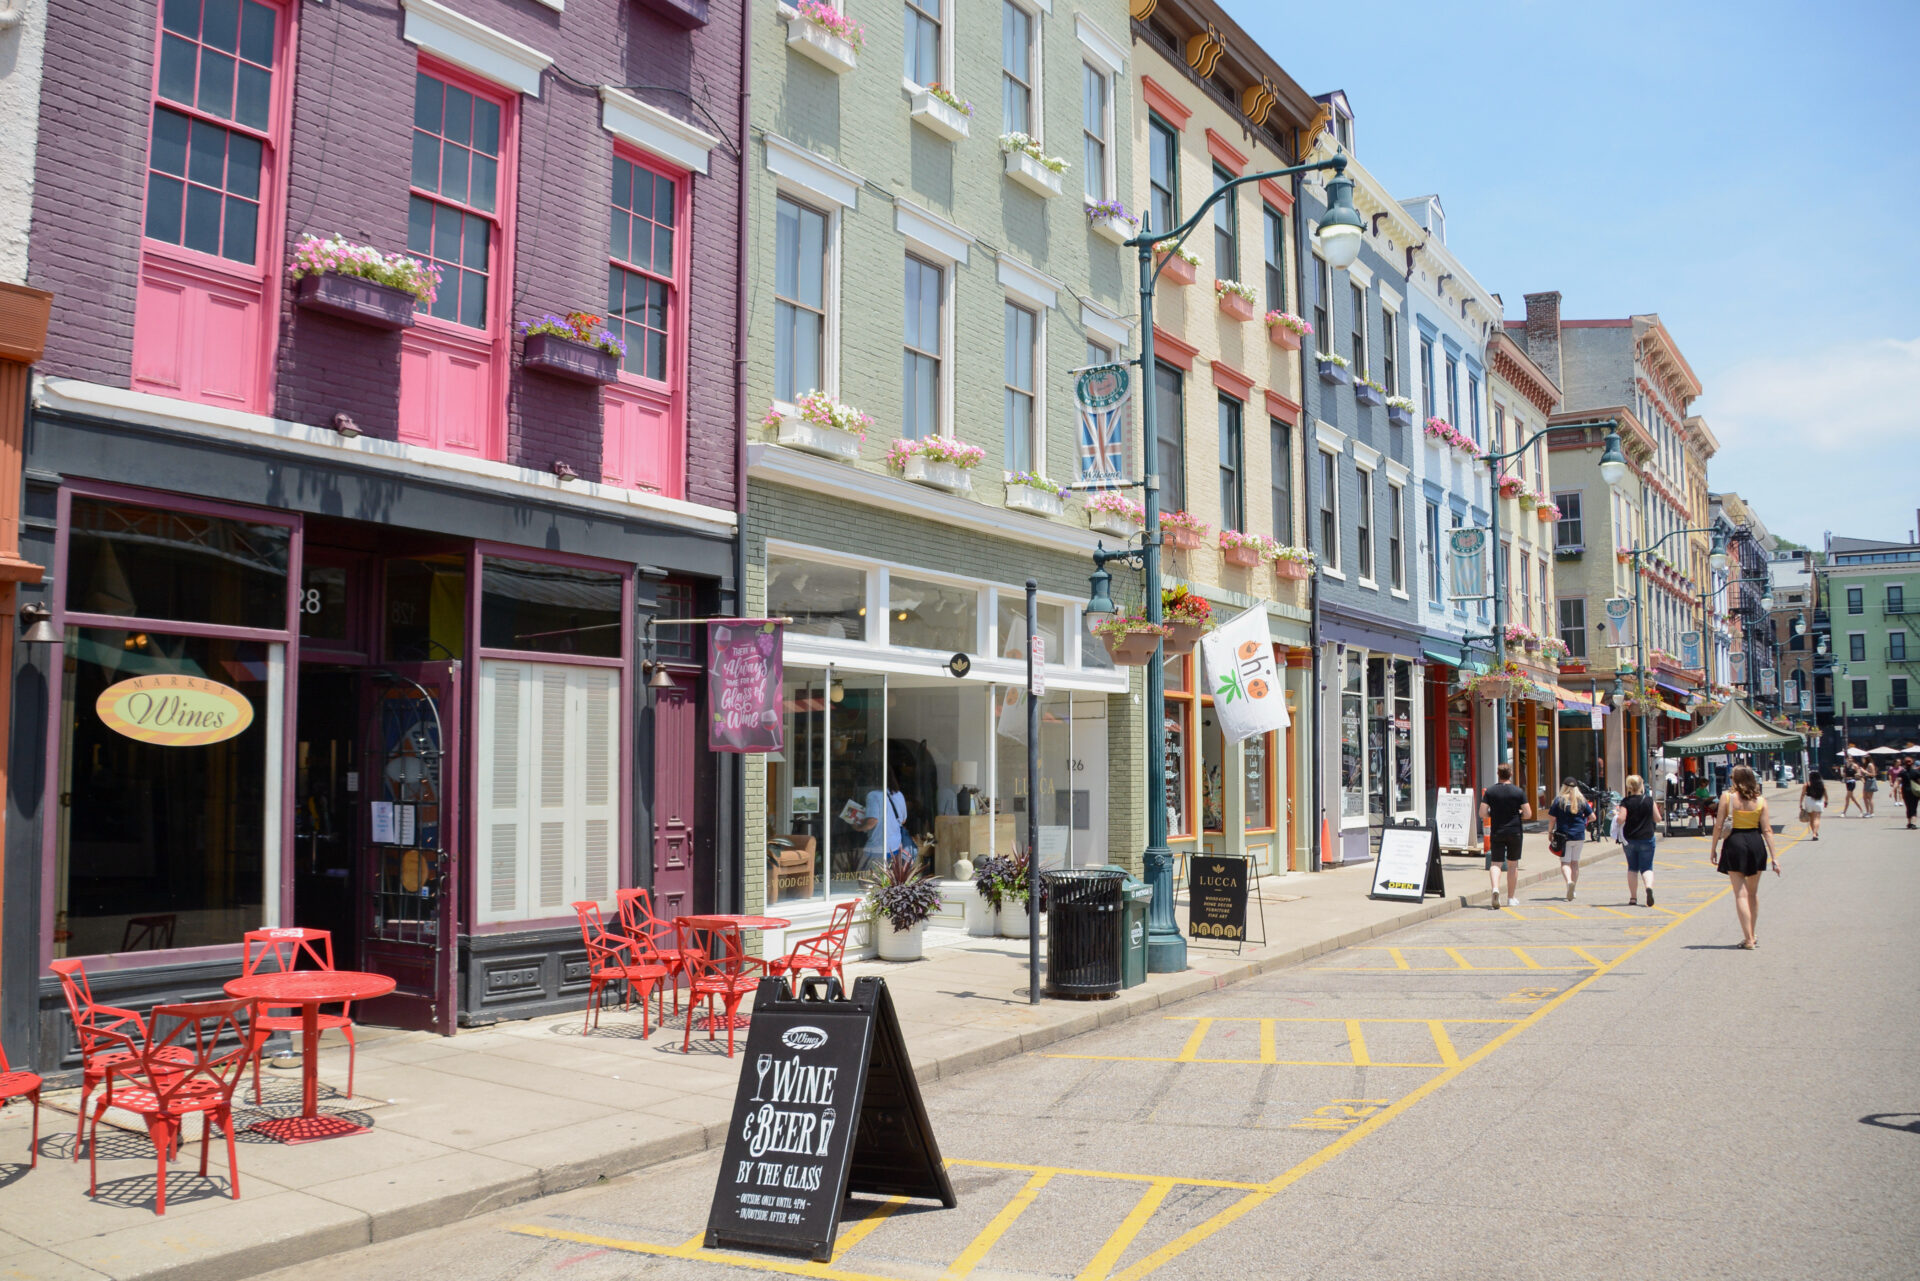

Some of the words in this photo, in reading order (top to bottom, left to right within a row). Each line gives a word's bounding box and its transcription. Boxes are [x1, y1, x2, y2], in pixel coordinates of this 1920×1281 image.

[724, 656, 768, 681] Always
[133, 676, 231, 695] MARKET
[721, 687, 752, 711] Glass
[754, 678, 767, 703] of
[127, 693, 225, 729] Wines
[727, 709, 759, 729] Wine
[1680, 745, 1726, 754] FINDLAY
[1738, 742, 1785, 750] MARKET
[1014, 777, 1055, 795] LUCA
[1200, 875, 1237, 888] LUCCA
[790, 1032, 819, 1044] Wines
[771, 1055, 838, 1106] WINE
[749, 1103, 817, 1158] BEER
[735, 1160, 755, 1184] BY
[756, 1162, 783, 1187] THE
[783, 1164, 823, 1192] GLASS
[740, 1193, 761, 1205] OUTSIDE
[761, 1194, 776, 1207] ONLY
[776, 1196, 792, 1209] UNTIL
[793, 1198, 806, 1210] 4PM
[739, 1207, 769, 1221] IN/OUTSIDE
[769, 1211, 787, 1224] AFTER
[788, 1213, 801, 1225] 4PM
